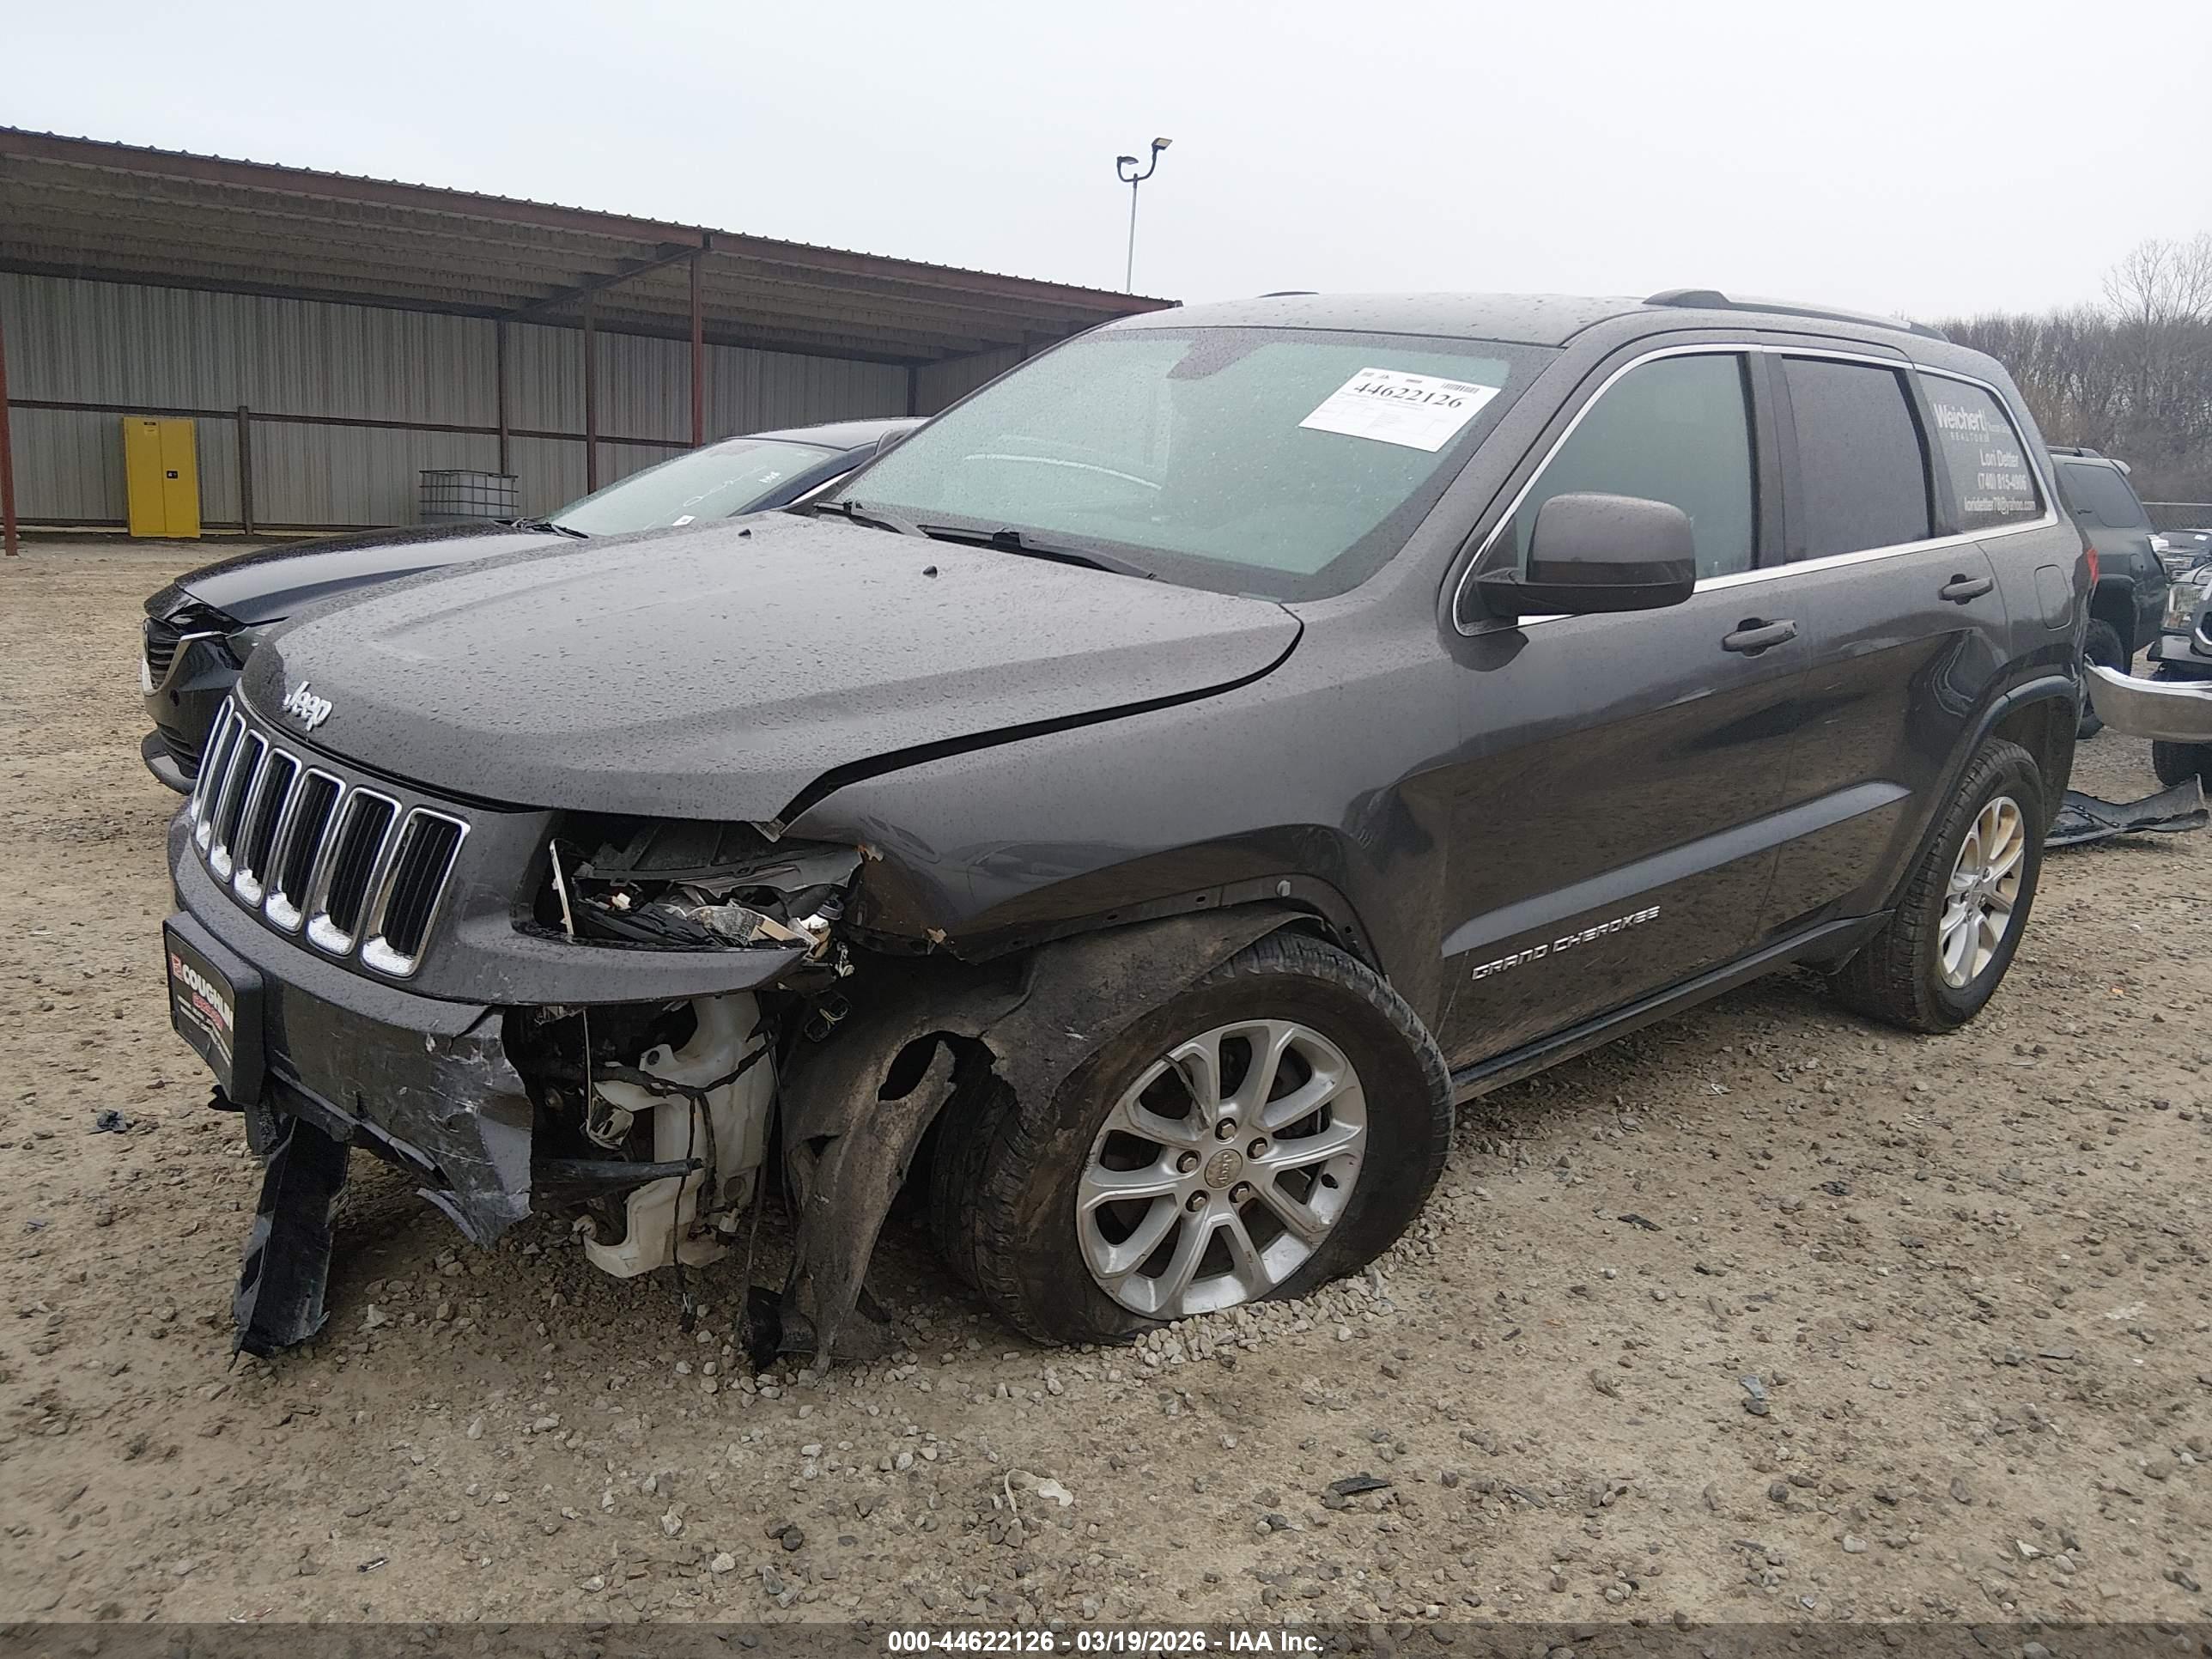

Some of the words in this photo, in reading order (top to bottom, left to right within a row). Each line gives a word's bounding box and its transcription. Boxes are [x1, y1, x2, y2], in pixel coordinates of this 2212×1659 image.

[1354, 382, 1462, 409] 44622126
[1934, 404, 1986, 431] Weichert
[1979, 448, 1996, 467] Lori
[282, 680, 332, 732] Jeep
[1472, 945, 1548, 980] GRAND
[1553, 905, 1661, 952] CHEROKEE
